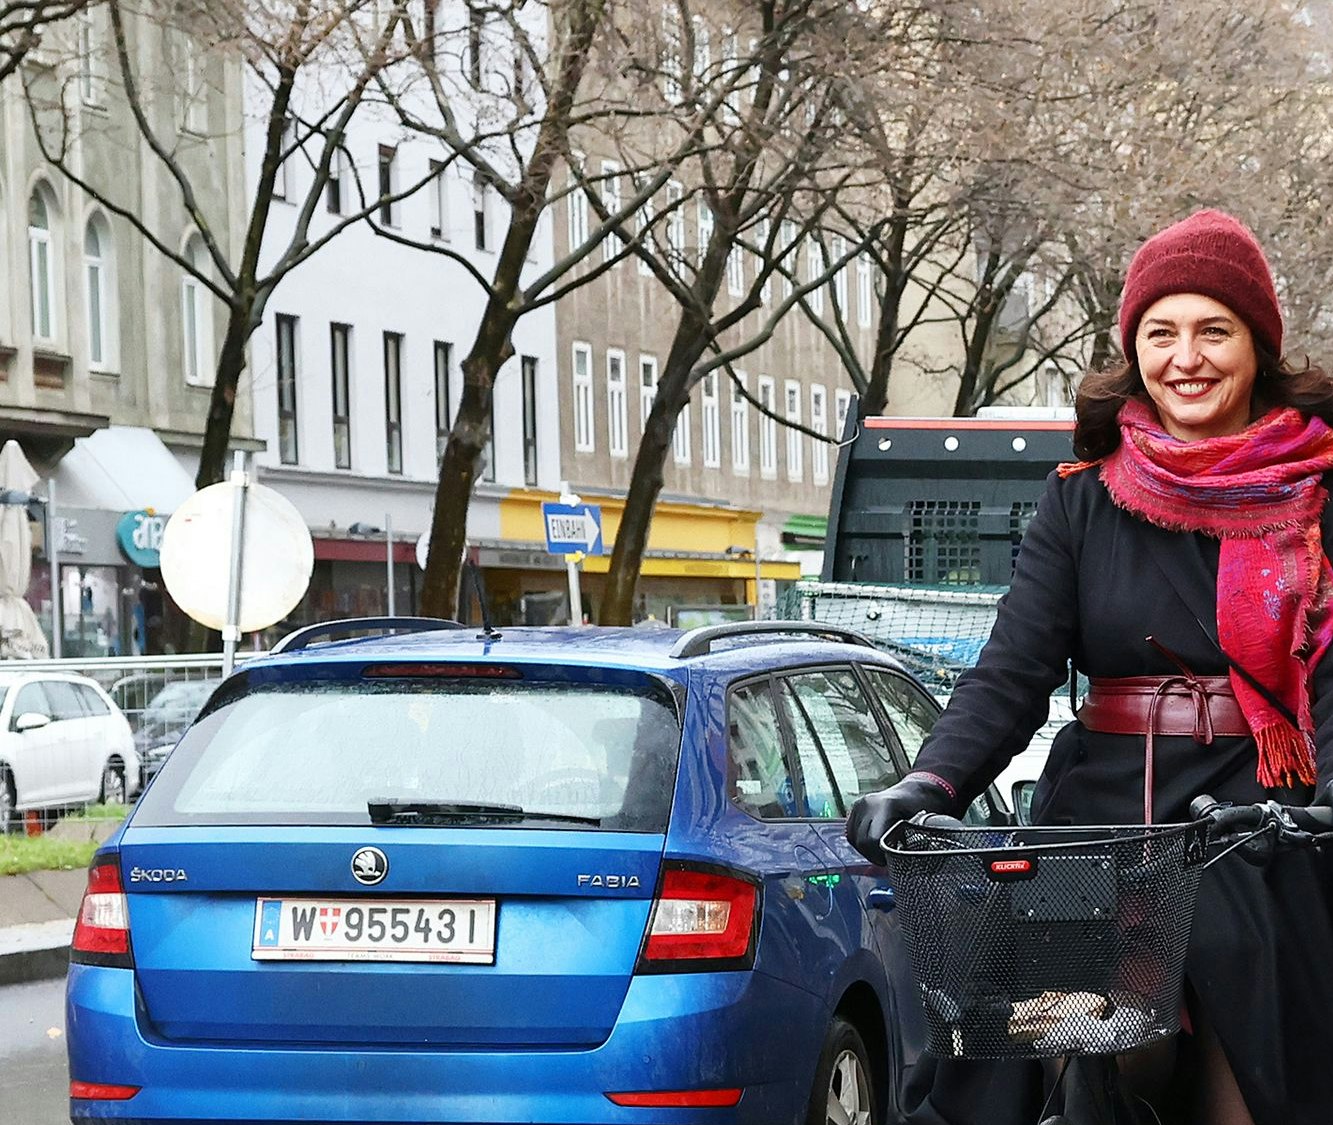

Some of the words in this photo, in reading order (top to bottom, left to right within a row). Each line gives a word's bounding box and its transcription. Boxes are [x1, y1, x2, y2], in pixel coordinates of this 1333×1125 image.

[550, 518, 586, 540] EINBAHN
[130, 866, 188, 882] ŠKODA
[577, 874, 641, 888] FABIA
[291, 906, 317, 942] W
